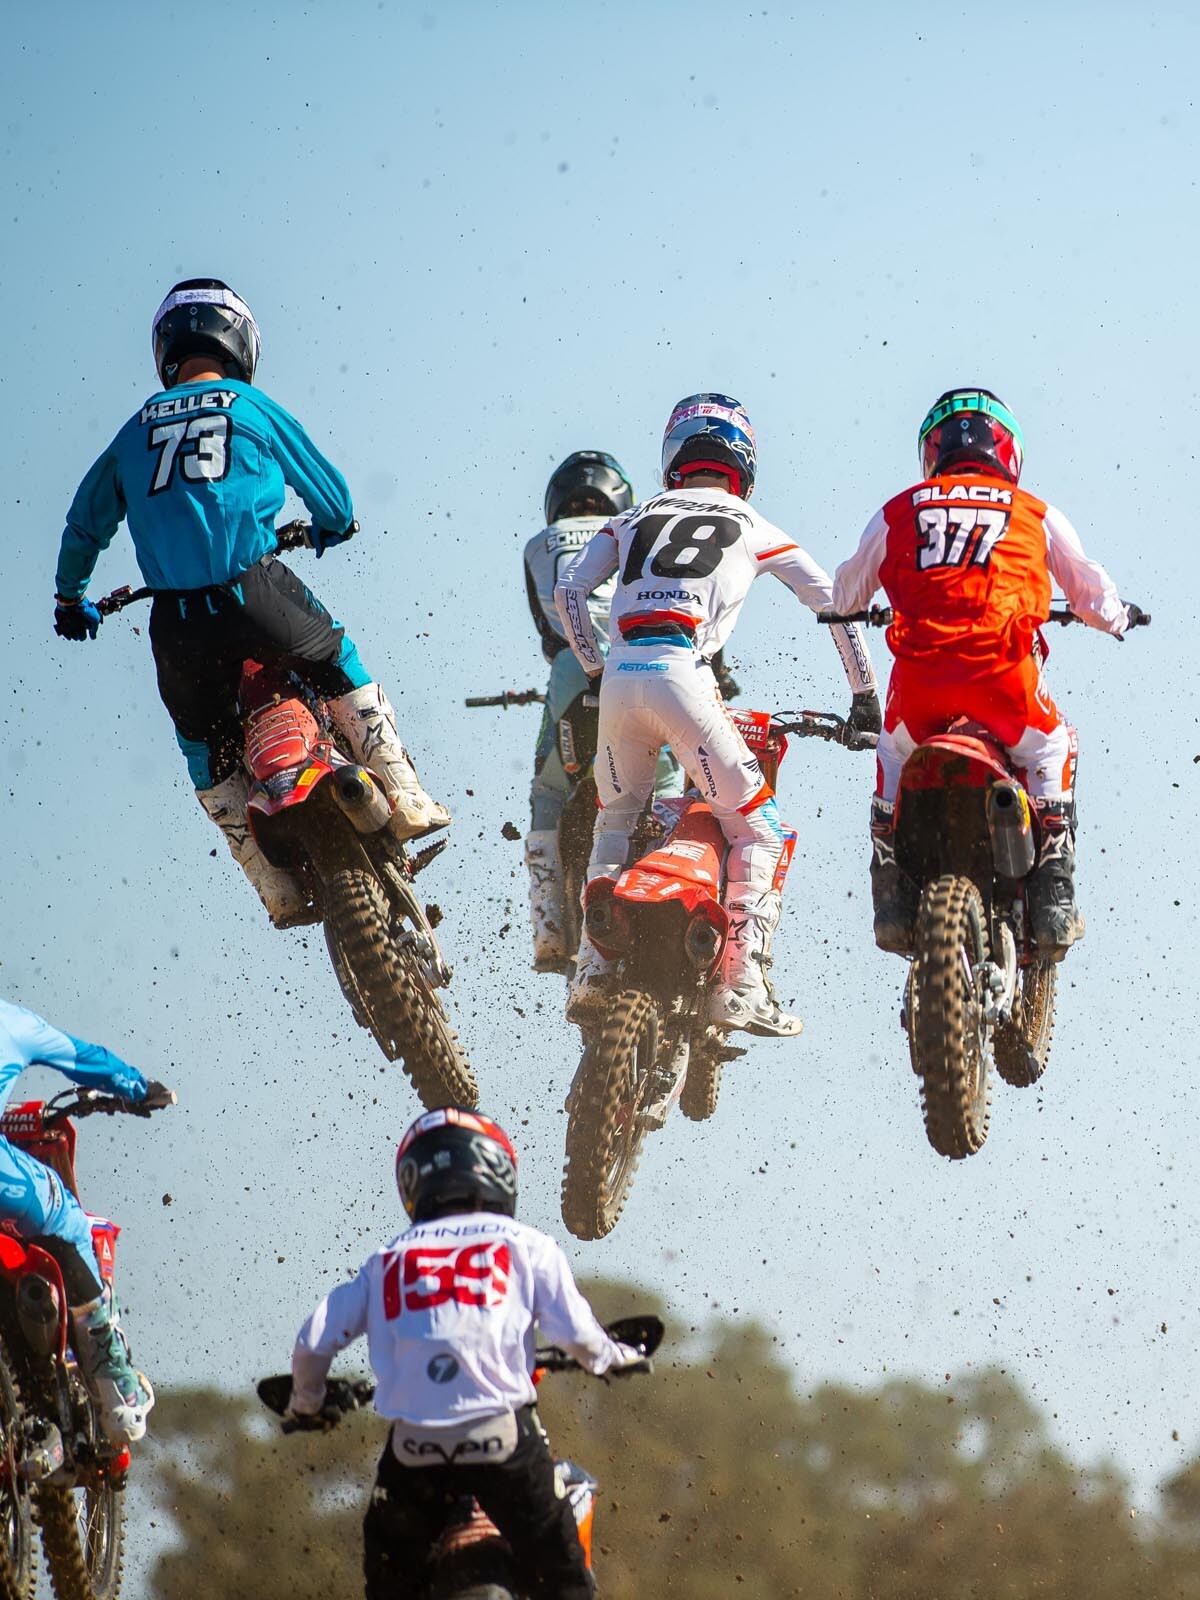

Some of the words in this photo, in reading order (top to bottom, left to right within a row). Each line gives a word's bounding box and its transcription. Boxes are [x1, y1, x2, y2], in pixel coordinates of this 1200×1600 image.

[140, 391, 239, 424] KELLEY
[151, 414, 231, 492] 73
[912, 485, 1012, 506] BLACK
[547, 530, 597, 549] SCHW
[621, 514, 742, 586] 18
[917, 507, 1009, 569] 377
[178, 582, 245, 620] FLY
[637, 591, 703, 606] HONDA
[616, 662, 669, 672] ASTARS
[606, 745, 620, 783] HONDA
[700, 757, 718, 798] HONDA
[1, 1113, 36, 1122] THAL
[1, 1124, 37, 1132] THAL
[383, 1240, 510, 1321] 159
